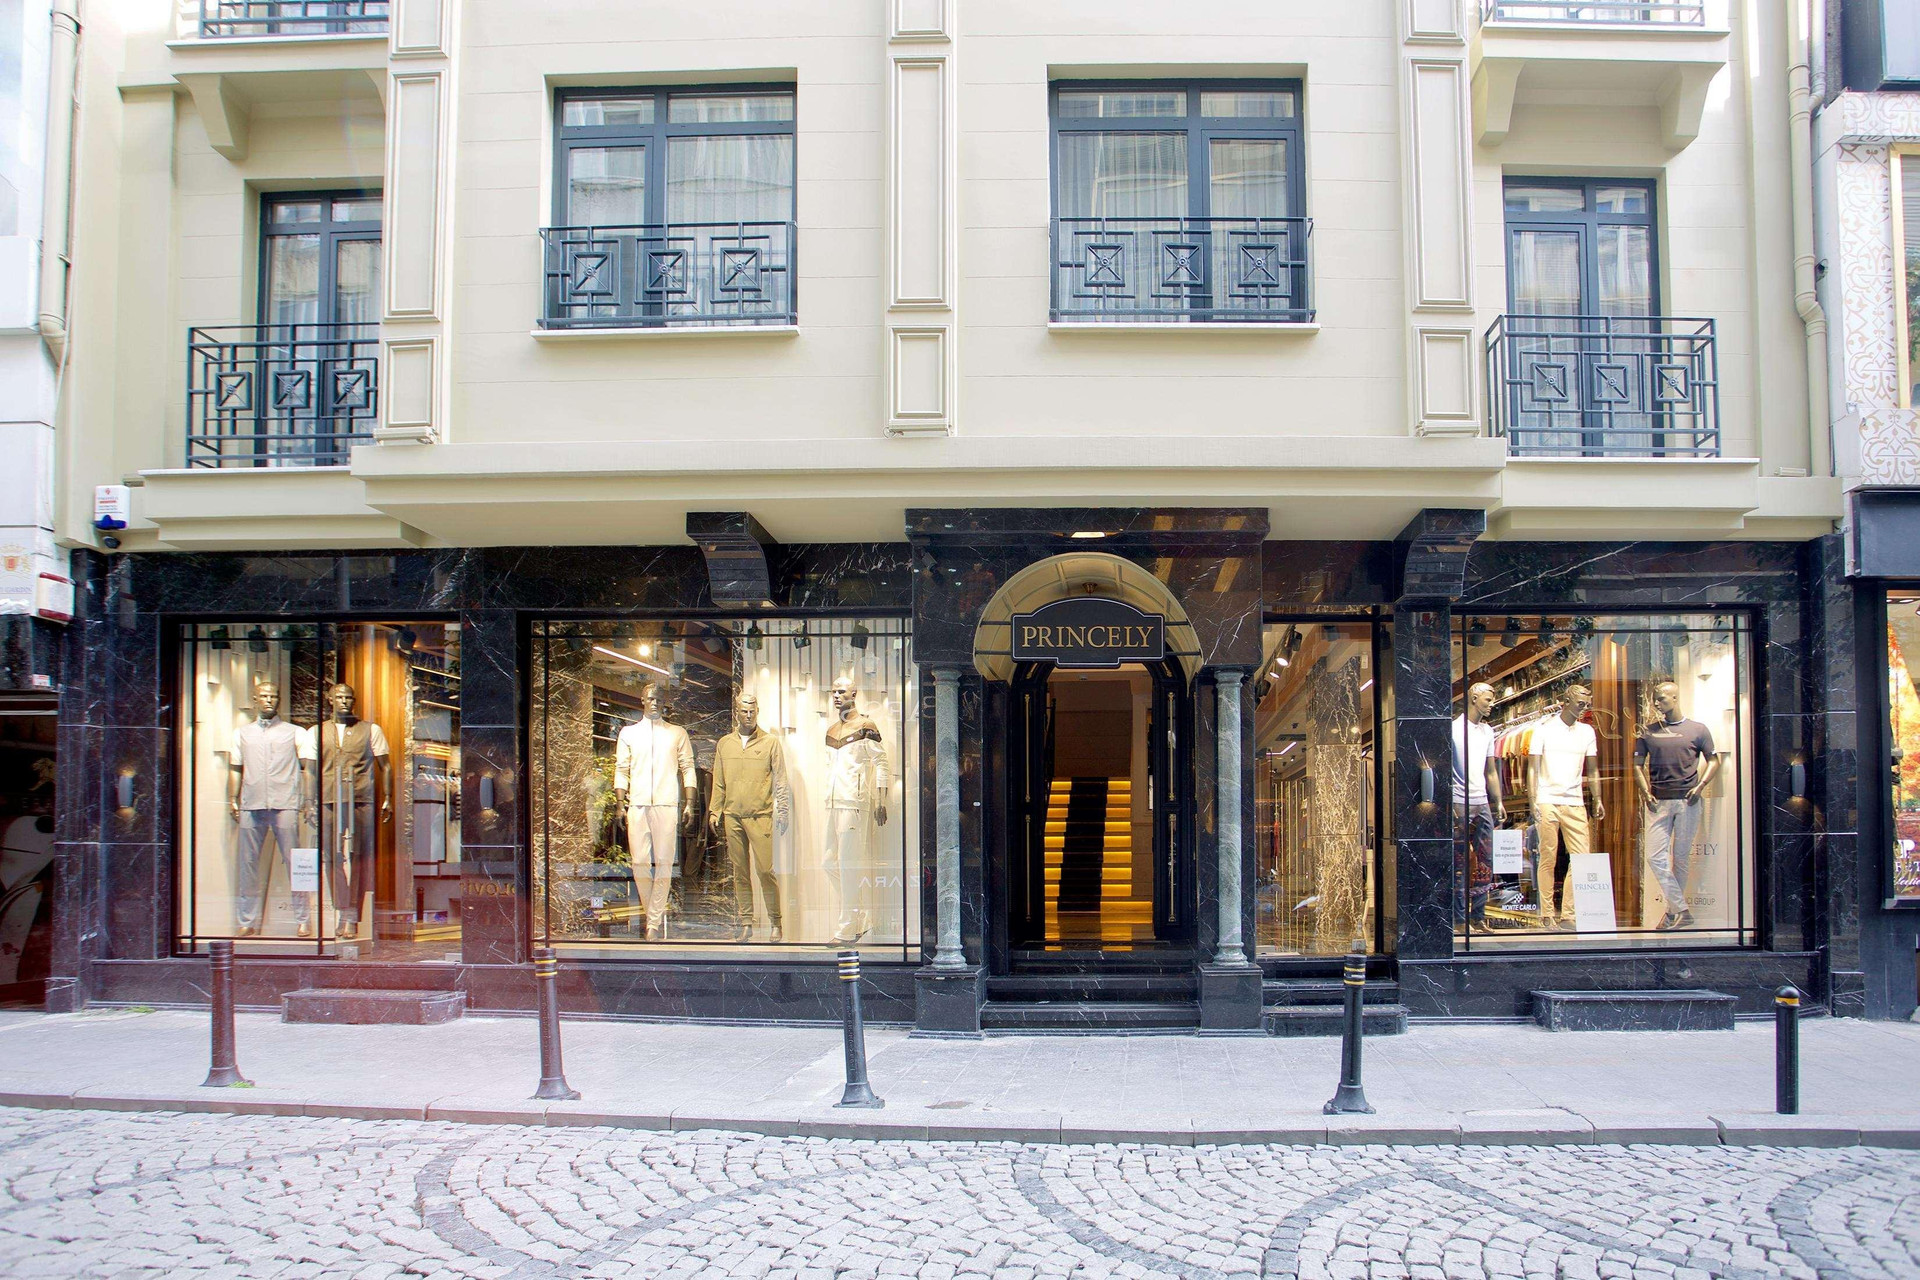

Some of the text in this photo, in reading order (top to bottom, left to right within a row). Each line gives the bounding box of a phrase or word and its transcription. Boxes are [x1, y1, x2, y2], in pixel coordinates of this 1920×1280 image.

[1021, 626, 1155, 648] PRINCELY
[1574, 882, 1611, 890] PRINCELY
[1519, 903, 1537, 911] CARLO
